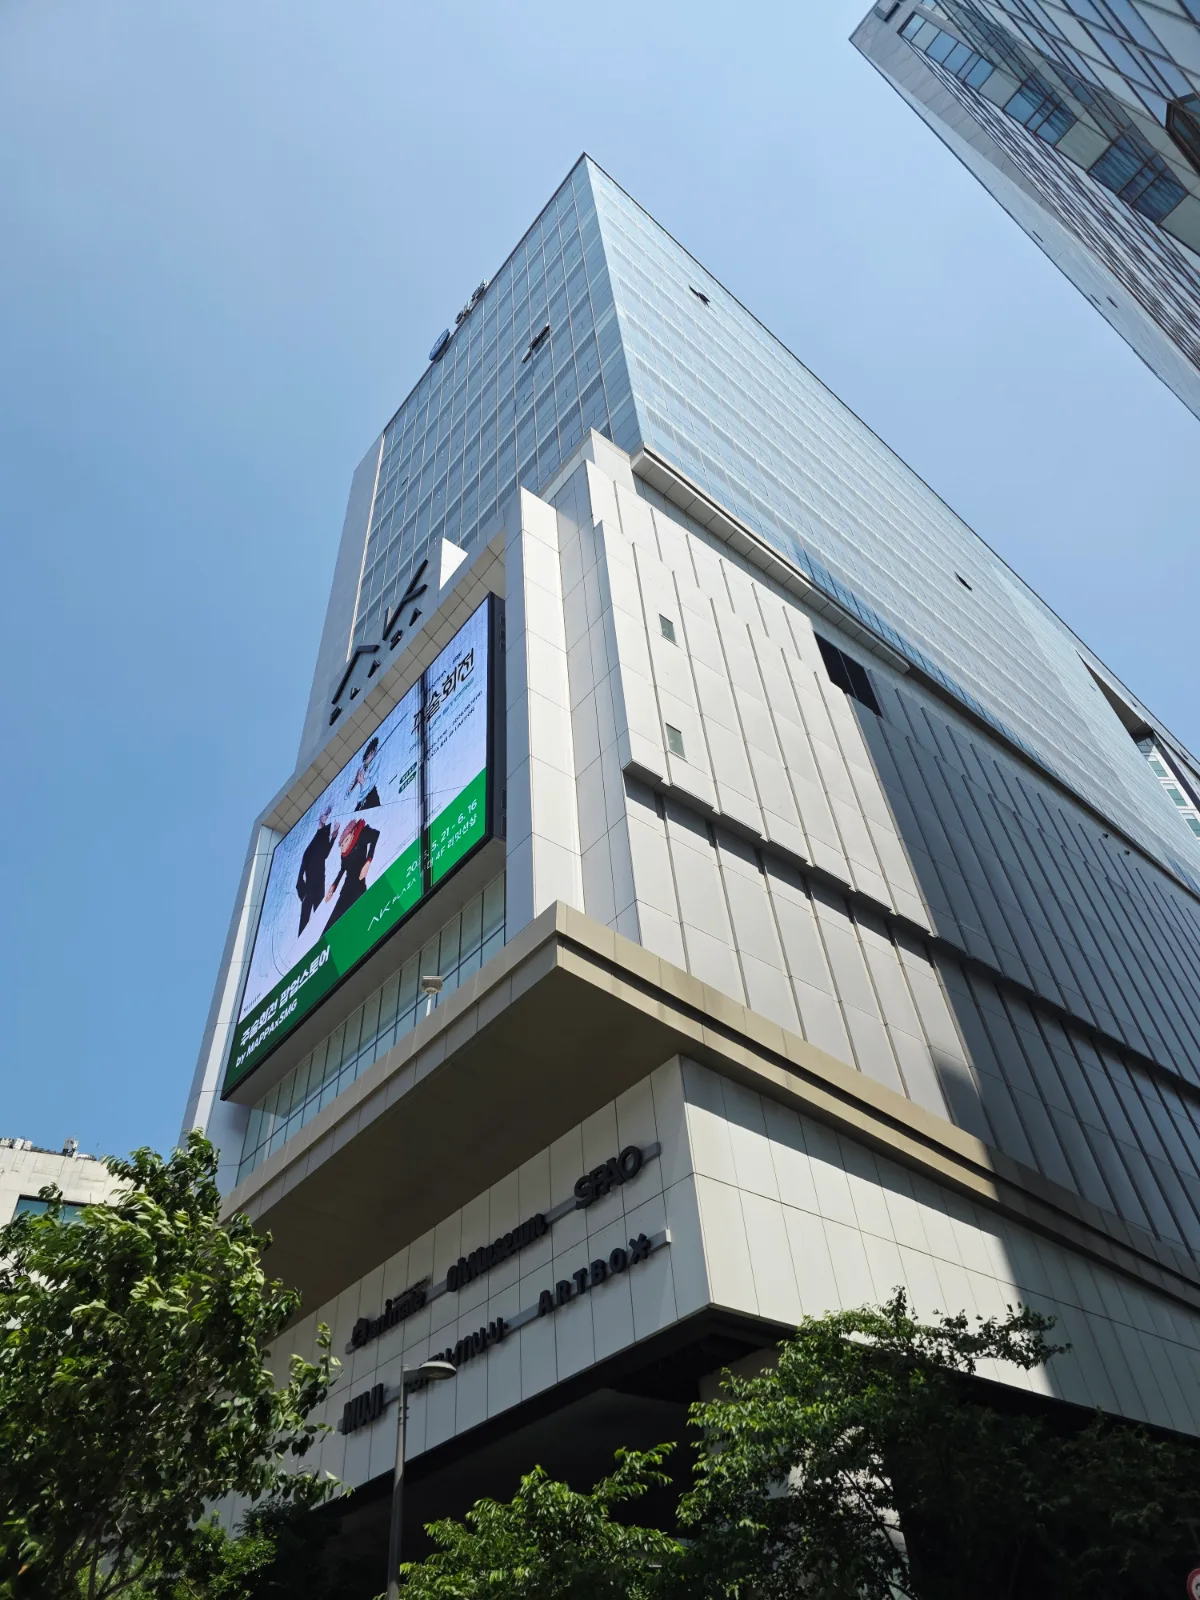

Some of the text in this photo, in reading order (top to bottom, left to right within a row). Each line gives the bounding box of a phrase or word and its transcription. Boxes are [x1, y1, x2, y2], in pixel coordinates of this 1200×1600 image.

[441, 827, 450, 842] 21
[468, 799, 478, 814] 16
[240, 945, 330, 1046] 주술회전 팝업스토어
[235, 1051, 247, 1068] by
[574, 1145, 643, 1210] SPAO
[342, 1233, 651, 1435] MUJI ARTBOX
